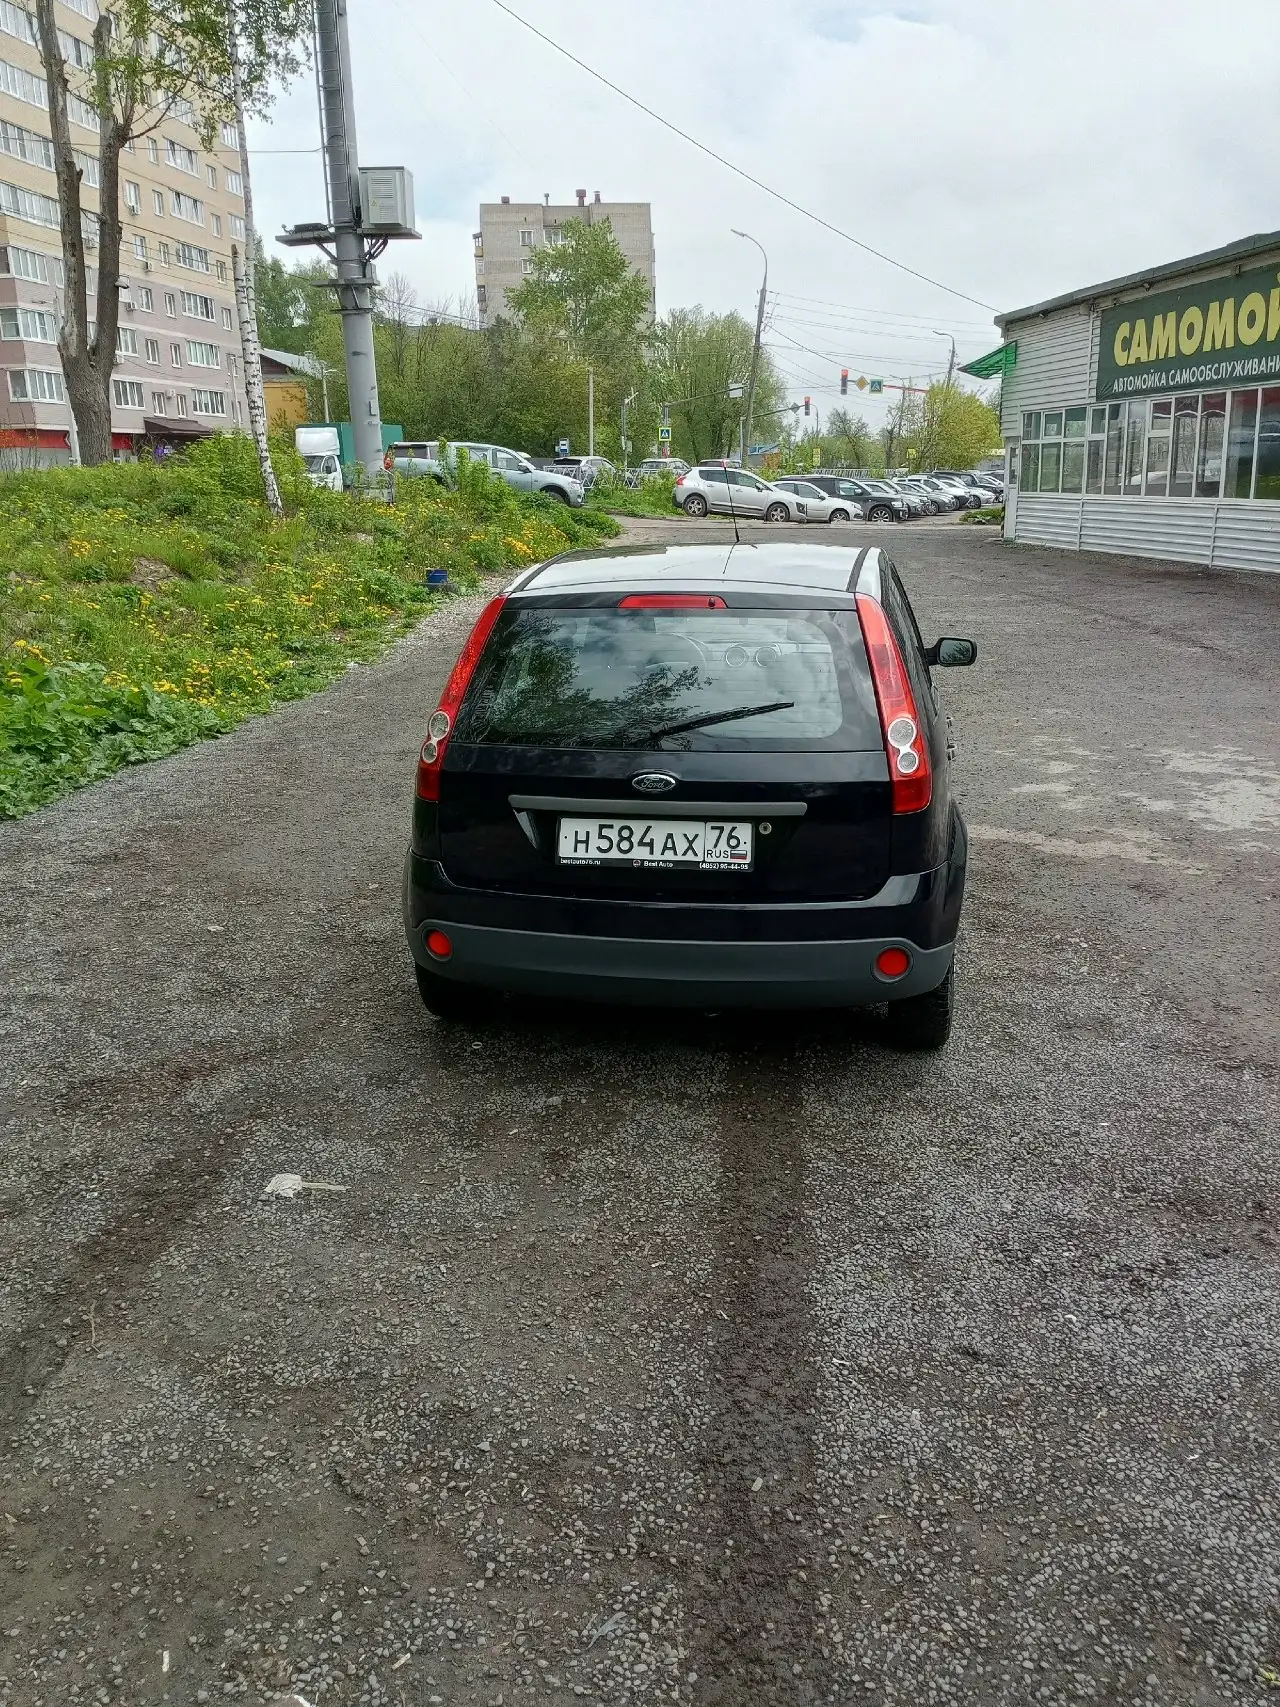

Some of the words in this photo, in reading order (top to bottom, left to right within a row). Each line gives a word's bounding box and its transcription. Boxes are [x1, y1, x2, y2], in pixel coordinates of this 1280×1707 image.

[1112, 369, 1166, 393] АВТОМОЙКА
[710, 826, 741, 850] 76
[707, 849, 729, 859] RUS
[699, 862, 719, 870] (4852)
